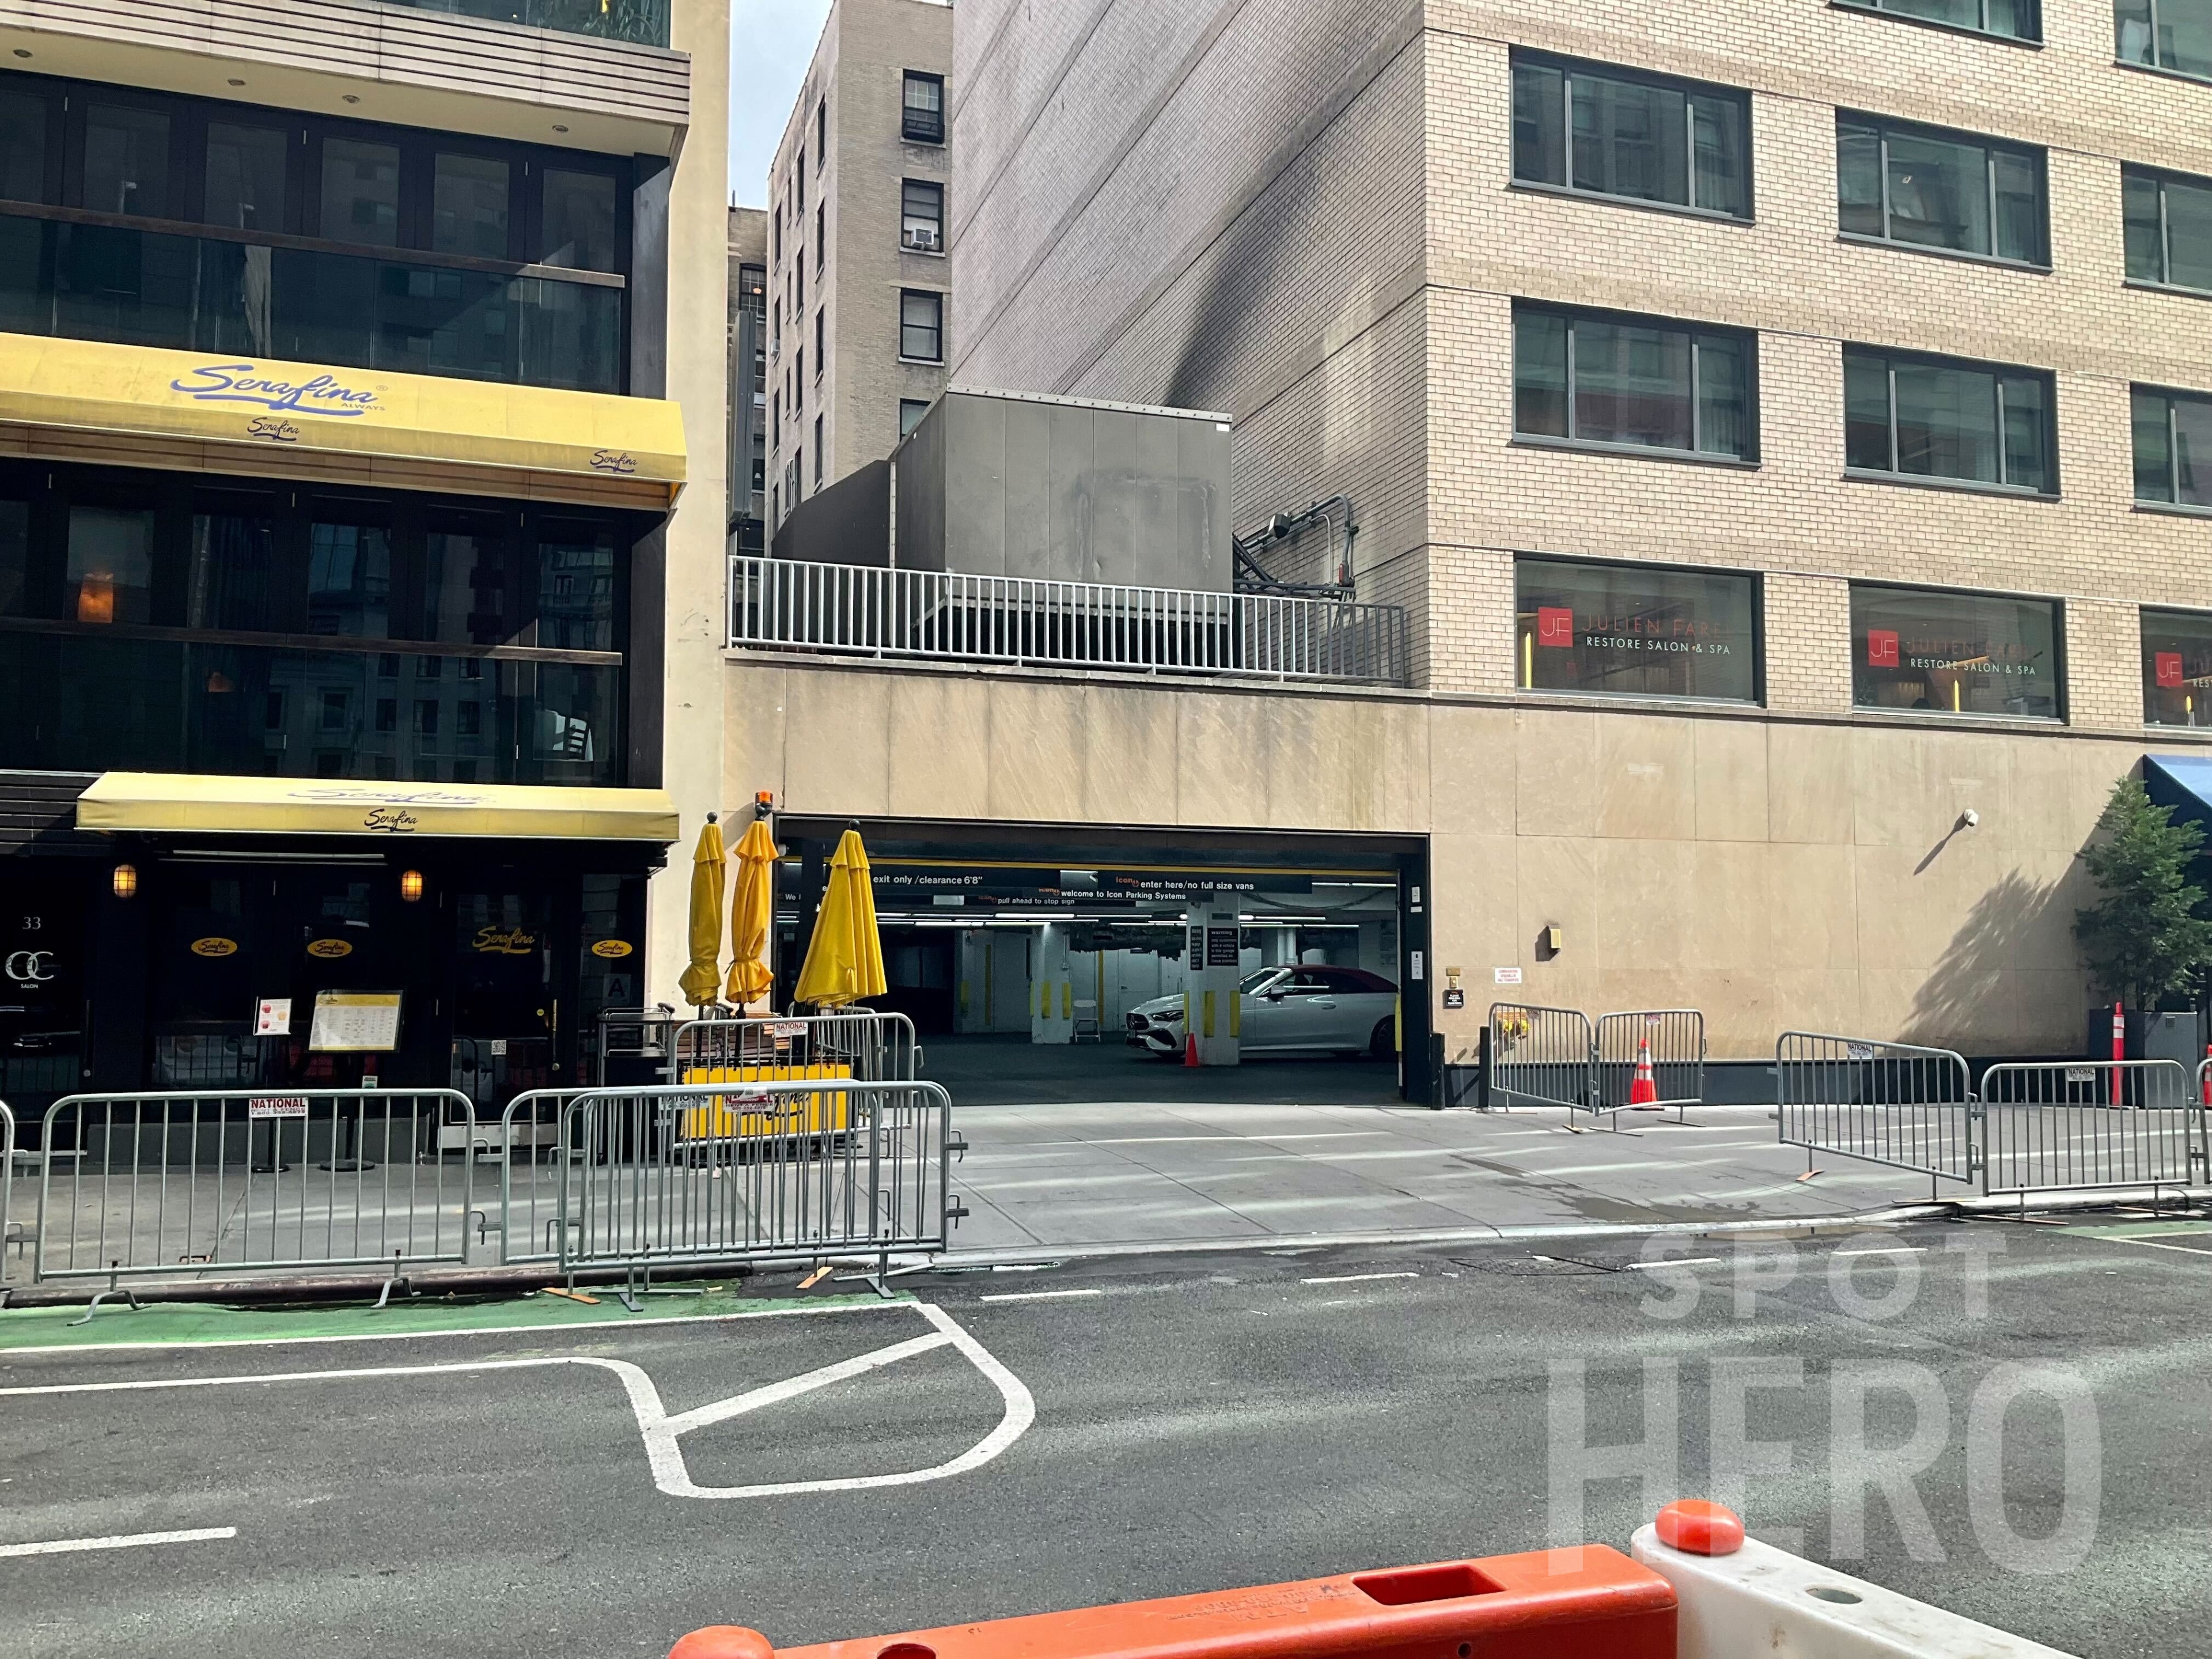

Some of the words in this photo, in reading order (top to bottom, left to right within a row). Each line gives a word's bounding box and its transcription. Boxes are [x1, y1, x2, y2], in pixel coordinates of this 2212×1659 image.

[170, 364, 378, 416] Serafina
[341, 402, 385, 411] ALWAYS
[247, 416, 300, 441] Serafina
[590, 450, 638, 473] Serafina
[1582, 614, 1660, 633] JULIEN
[1586, 636, 1641, 650] RESTORE
[1647, 640, 1689, 653] SALON
[1695, 643, 1703, 653] &
[1709, 645, 1730, 655] SPA
[1910, 658, 1958, 671] RESTORE
[1963, 662, 2000, 673] SALON
[2005, 665, 2012, 675] &
[2017, 665, 2036, 676] SPA
[364, 808, 419, 832] Serafina
[893, 875, 912, 885] only
[1165, 880, 1198, 889] here/no
[1126, 891, 1153, 900] Parking
[1155, 892, 1187, 900] Systems
[22, 916, 41, 930] 33
[472, 925, 535, 954] Serafina
[607, 978, 626, 997] A
[776, 1022, 806, 1030] NATIONAL
[1847, 1043, 1872, 1052] NATIONAL
[250, 1098, 306, 1109] NATIONAL
